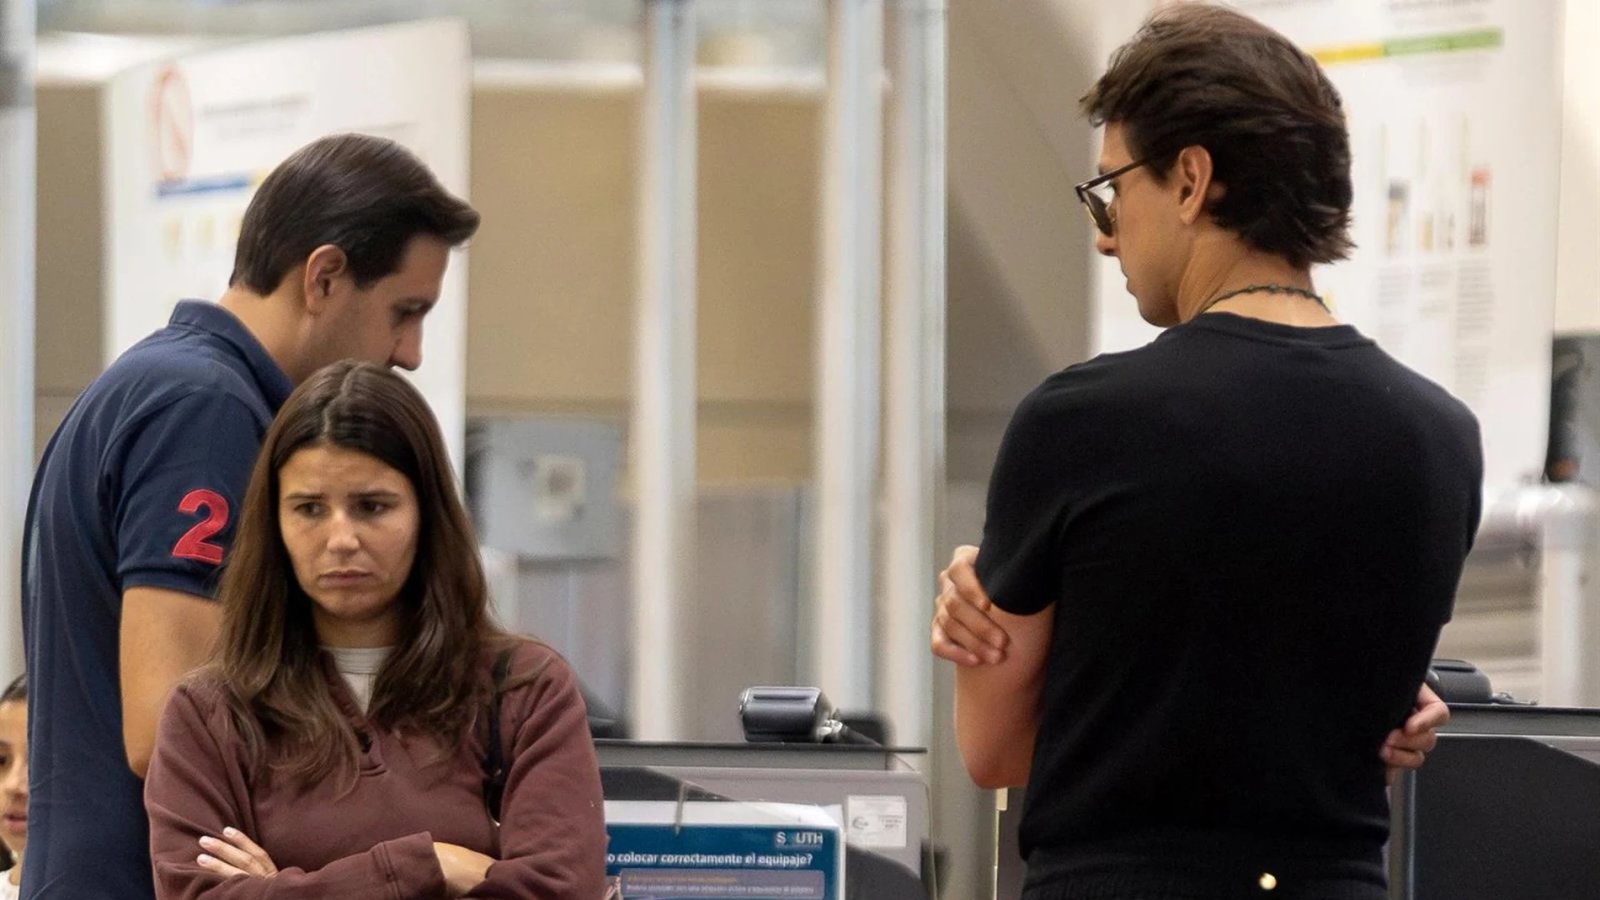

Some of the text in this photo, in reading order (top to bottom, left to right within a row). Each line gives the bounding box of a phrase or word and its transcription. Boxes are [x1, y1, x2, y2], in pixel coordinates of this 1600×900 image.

[172, 488, 230, 565] 2
[617, 851, 658, 863] colocar
[660, 853, 742, 865] correctamente
[745, 852, 756, 864] el
[758, 853, 813, 867] equipaje?
